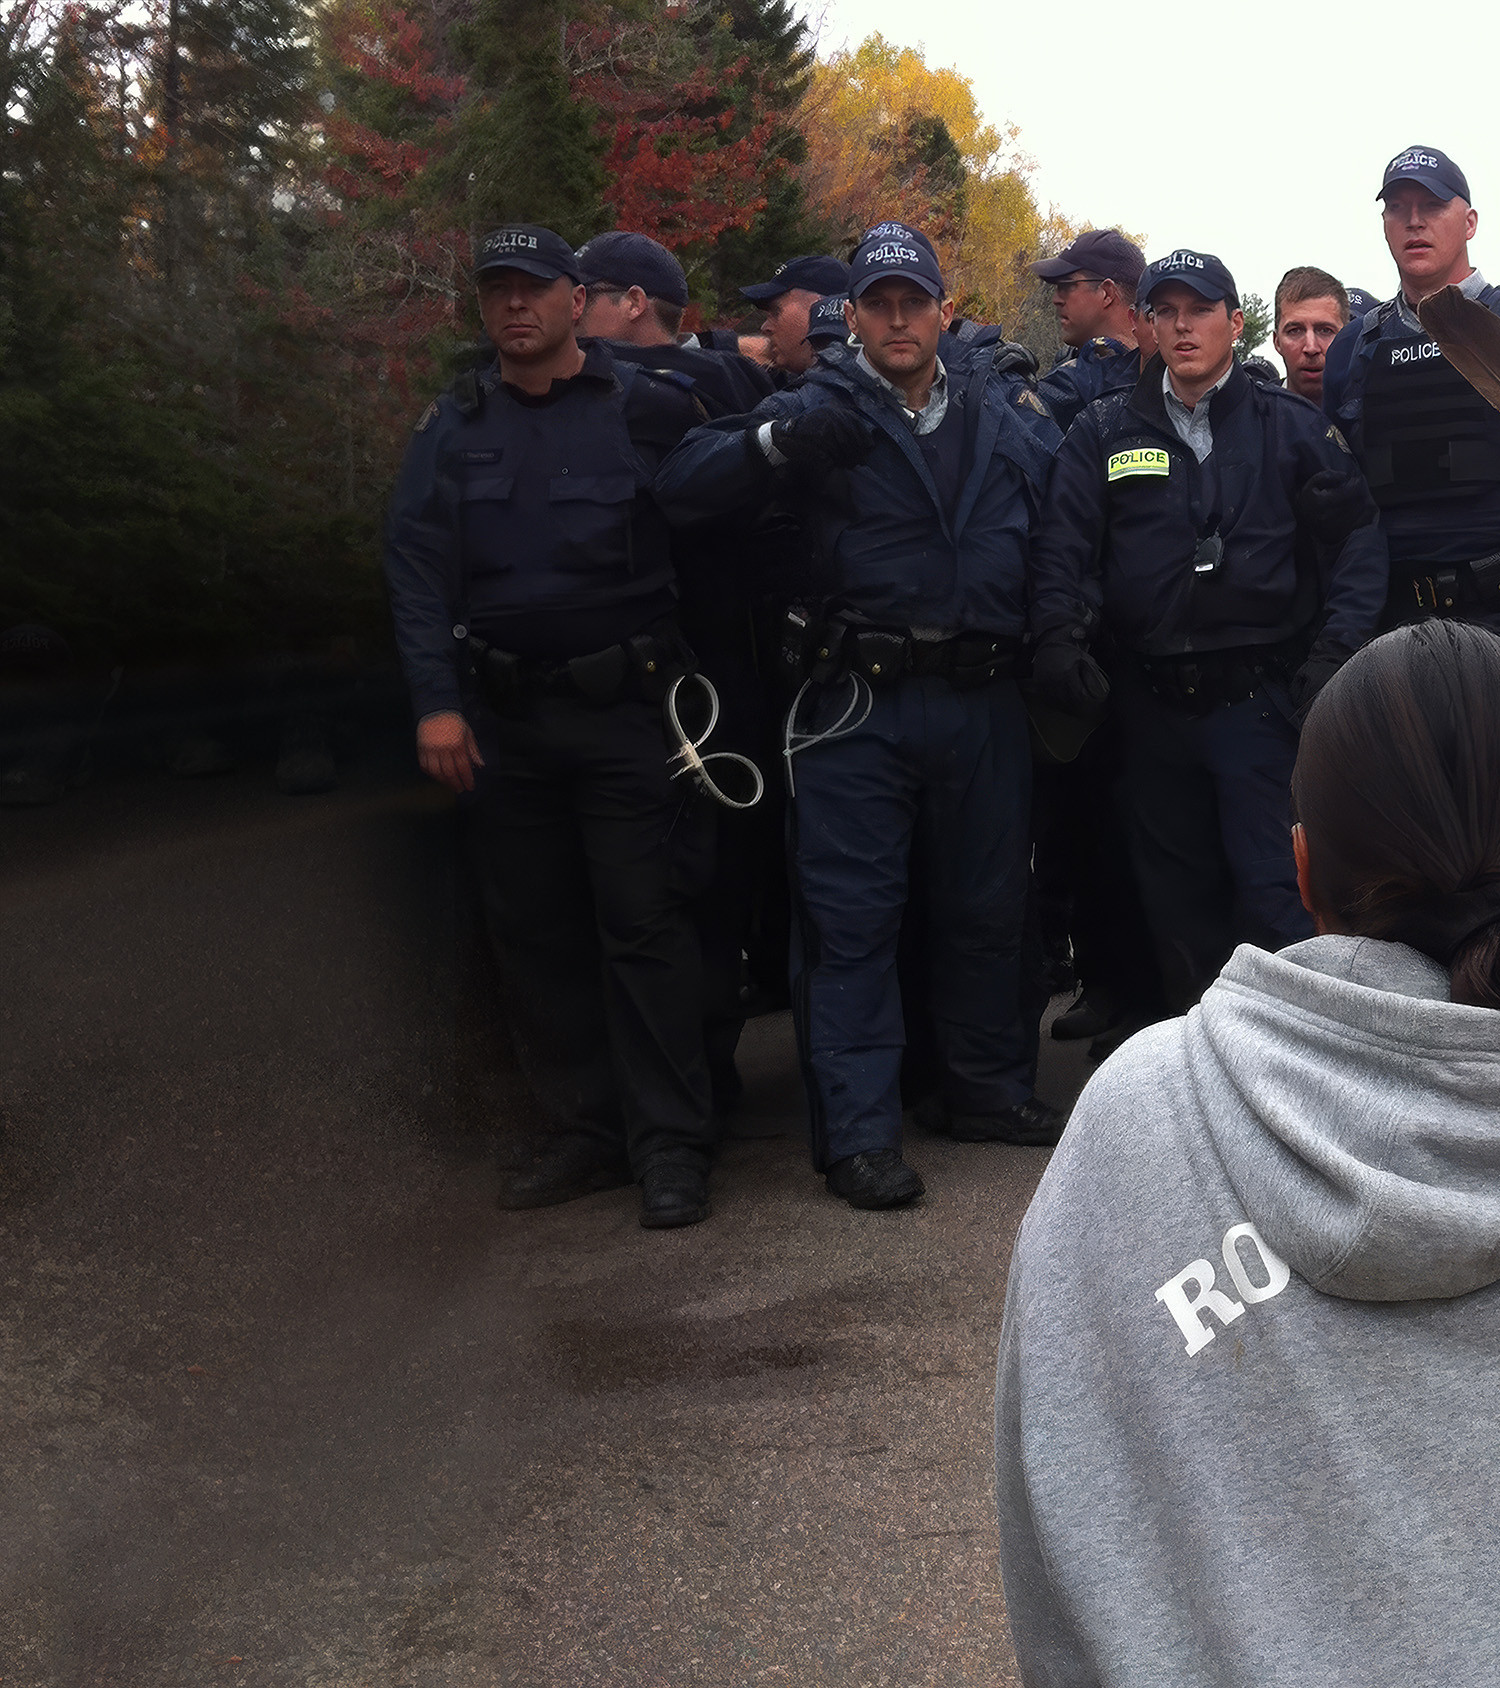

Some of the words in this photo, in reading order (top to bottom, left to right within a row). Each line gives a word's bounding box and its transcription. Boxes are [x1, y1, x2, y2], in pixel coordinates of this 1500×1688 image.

[483, 233, 537, 252] POLICE
[866, 245, 919, 264] POLICE
[1159, 252, 1204, 271] POLICE
[1391, 342, 1441, 365] POLICE
[1110, 451, 1166, 469] POLICE
[1154, 1222, 1290, 1358] RO
